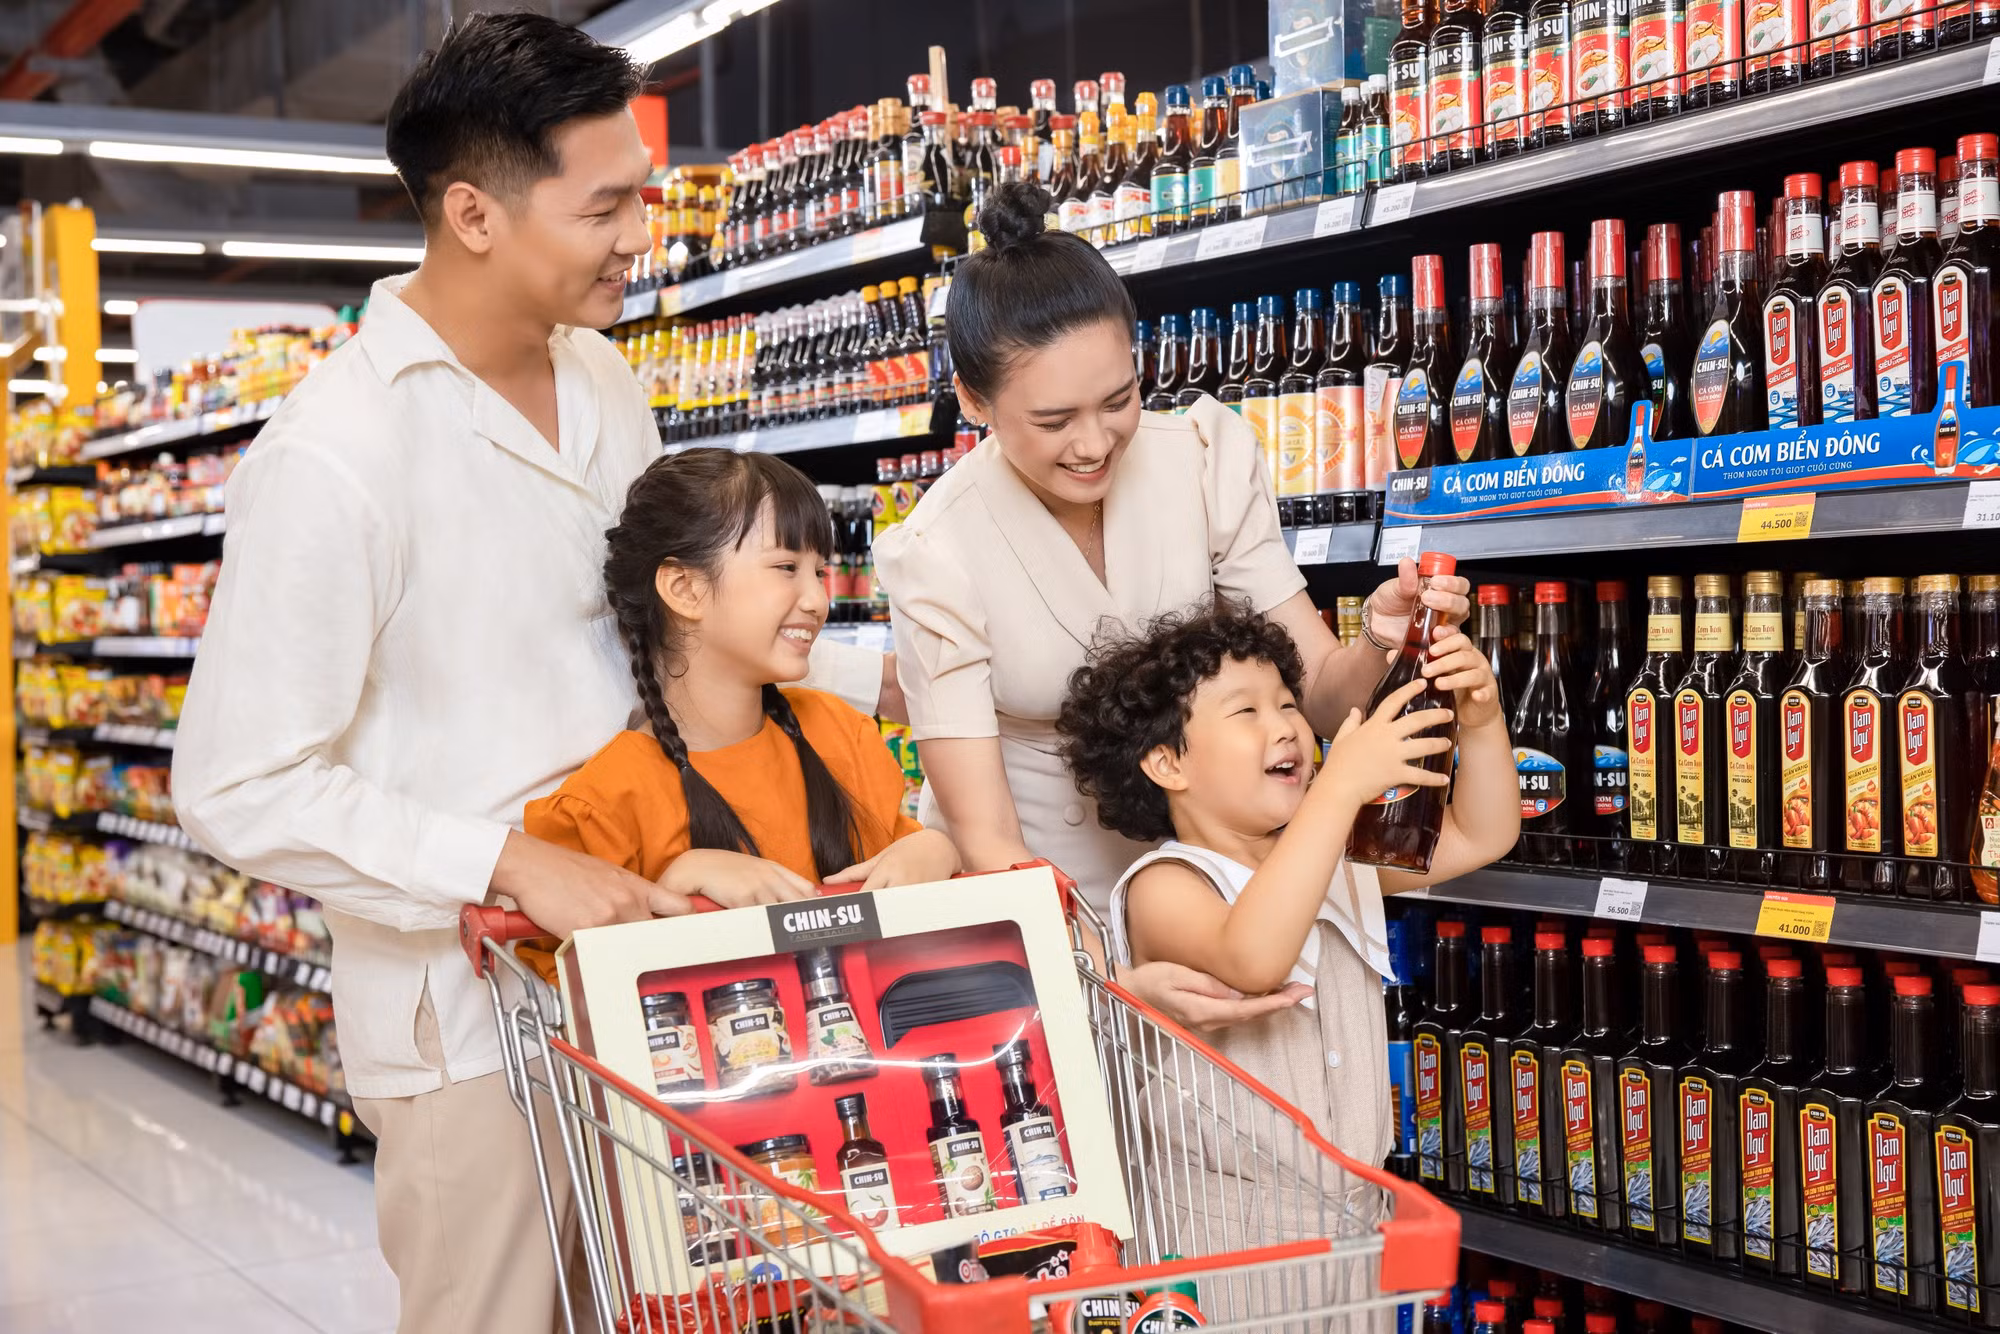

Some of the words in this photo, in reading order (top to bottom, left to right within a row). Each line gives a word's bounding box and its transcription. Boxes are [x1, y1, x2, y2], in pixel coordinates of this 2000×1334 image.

[1572, 0, 1628, 24] CHIN-SU
[1529, 19, 1563, 41] IN-SU
[1482, 33, 1528, 55] HIN-SU
[1428, 47, 1473, 68] HIN-SU
[1943, 289, 1959, 308] Nam
[1828, 307, 1843, 326] Nam
[1882, 299, 1898, 318] Nam
[1772, 316, 1788, 335] Nam
[1696, 358, 1728, 373] CHIN-SU
[1511, 386, 1539, 400] CHIN-SU
[1571, 378, 1600, 391] CHIN-SU
[1397, 402, 1427, 415] CHIN-SU
[1454, 394, 1481, 407] CHIN-SU
[1701, 443, 1724, 469] CÁ
[1730, 443, 1771, 465] CƠM
[1776, 430, 1820, 462] BIỂN
[1825, 430, 1880, 457] ĐÔNG
[1443, 470, 1462, 494] CÁ
[1466, 472, 1498, 492] CƠM
[1503, 460, 1537, 488] BIỂN
[1541, 460, 1585, 484] ĐÔNG
[1746, 469, 1768, 478] NGON
[1829, 460, 1852, 469] CÙNG
[1391, 475, 1428, 493] CHIN-SU
[1479, 494, 1497, 502] NGON
[1761, 518, 1792, 530] 44.500
[1976, 512, 2000, 521] 31.10
[1634, 706, 1648, 723] Nam
[1682, 707, 1696, 724] Nam
[1734, 709, 1749, 726] Nam
[1787, 710, 1802, 728] Nam
[1853, 710, 1870, 729] Nam
[1907, 712, 1925, 731] Nam
[1519, 775, 1550, 790] N-SU
[1593, 772, 1626, 787] N-SU
[783, 904, 862, 933] CHIN-SU
[1607, 905, 1629, 915] 56.500
[1778, 923, 1810, 936] 41.000
[734, 1017, 765, 1030] CHIN-SU
[822, 1009, 850, 1022] CHIN-SU
[649, 1035, 676, 1047] HIN-SU
[1419, 1050, 1436, 1070] Nam
[1466, 1060, 1484, 1080] Nam
[1516, 1068, 1534, 1089] Nam
[1567, 1078, 1586, 1099] Nam
[1626, 1086, 1645, 1108] Nam
[1686, 1094, 1707, 1117] Nam
[1747, 1107, 1768, 1130] Nam
[1024, 1125, 1051, 1138] CHIN-SU
[1808, 1124, 1830, 1147] Nam
[951, 1140, 979, 1153] CHIN-SU
[1876, 1133, 1899, 1158] Nam
[1943, 1146, 1967, 1172] Nam
[854, 1172, 884, 1185] CHIN-SU
[1080, 1299, 1140, 1318] CHINSU
